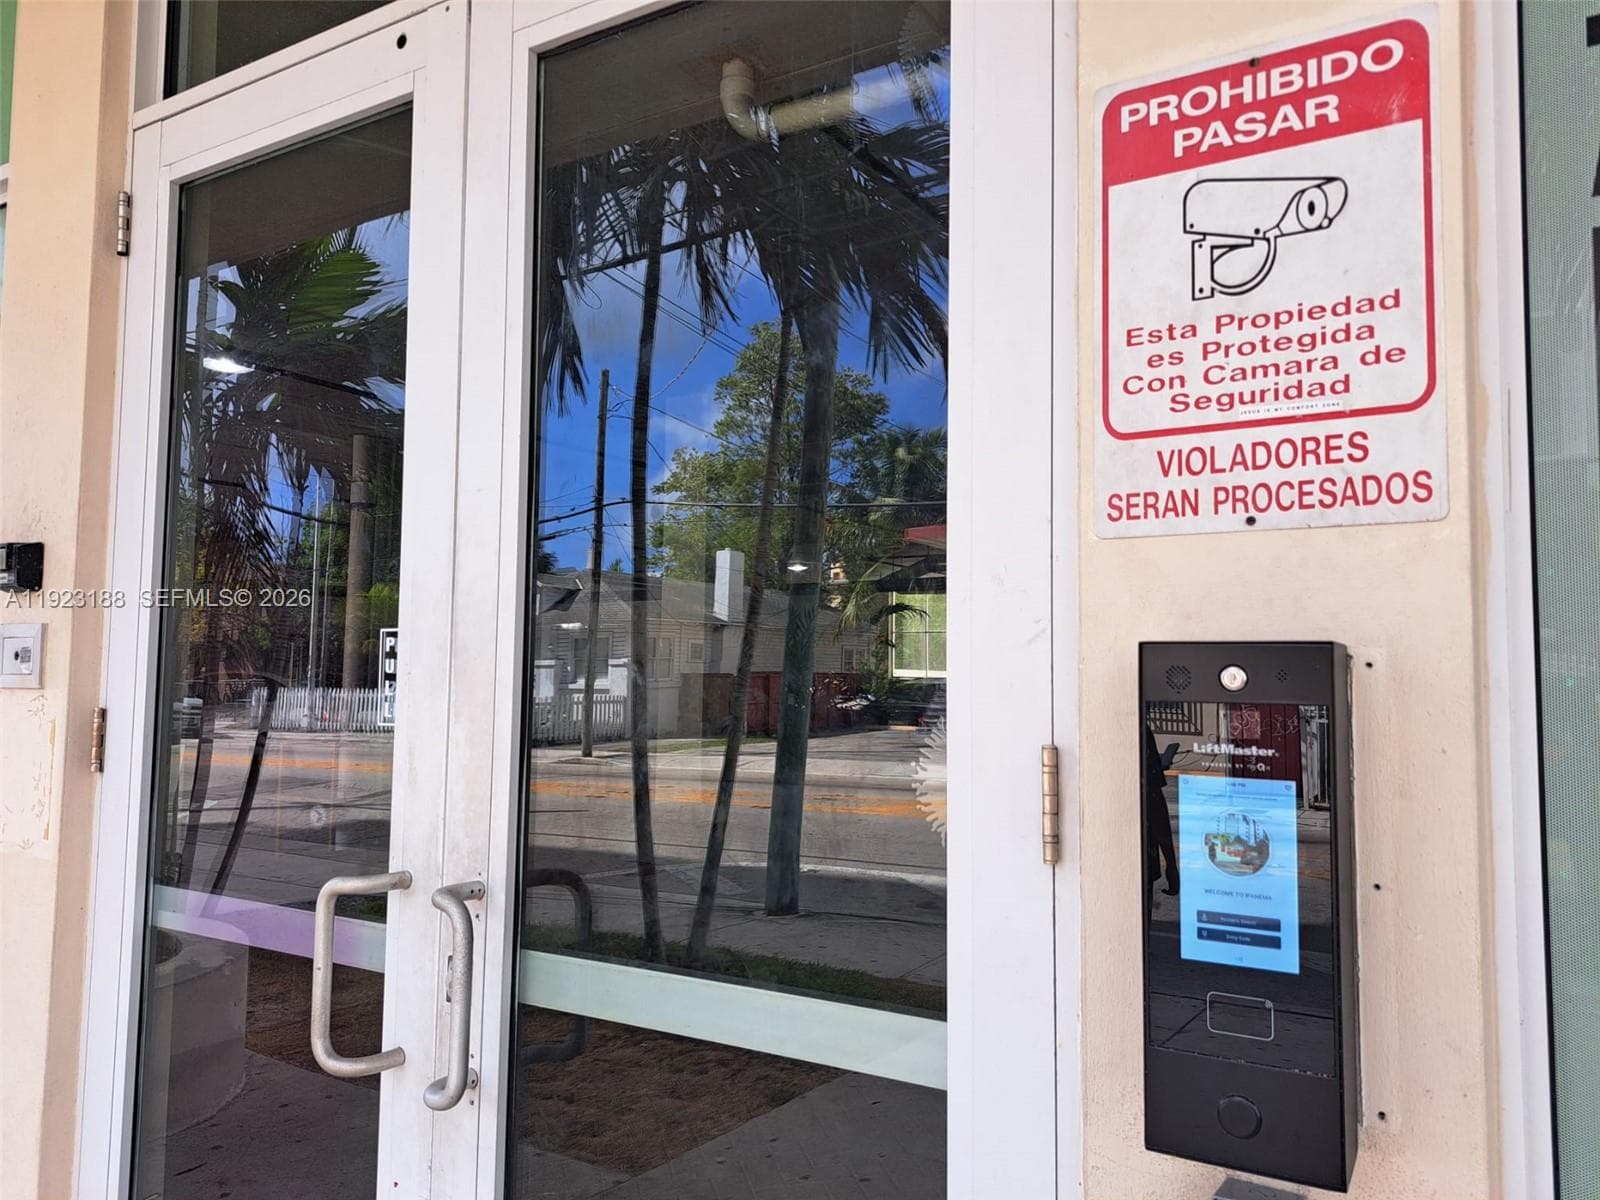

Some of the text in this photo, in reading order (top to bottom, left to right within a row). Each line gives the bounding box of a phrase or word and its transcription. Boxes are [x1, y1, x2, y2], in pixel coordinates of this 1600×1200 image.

[1120, 38, 1404, 133] PROHIBIDO
[1173, 95, 1340, 158] PASAR
[1126, 288, 1402, 348] Esta Propiedad
[1122, 344, 1407, 396] Con Camara de
[1147, 323, 1376, 369] es Protegida
[1169, 374, 1352, 413] Seguridad
[1157, 431, 1371, 478] VIOLADORES
[1107, 469, 1435, 523] SERAN PROCESADOS
